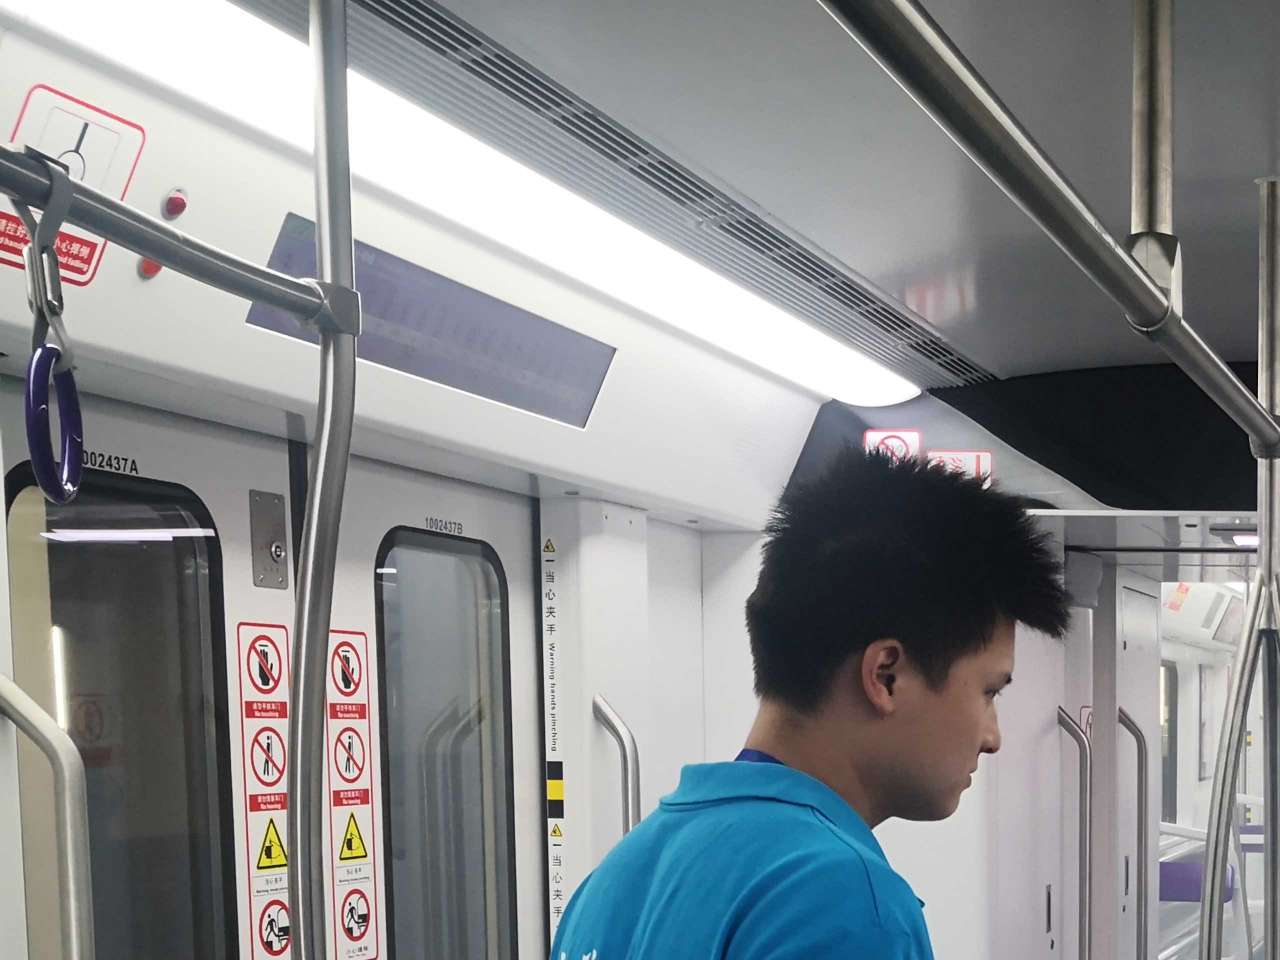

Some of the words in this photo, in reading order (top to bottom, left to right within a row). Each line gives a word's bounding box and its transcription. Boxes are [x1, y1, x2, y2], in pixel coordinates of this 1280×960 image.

[82, 450, 139, 475] 002437A
[425, 516, 463, 535] 1002437B
[551, 855, 563, 918] 当心夹手
